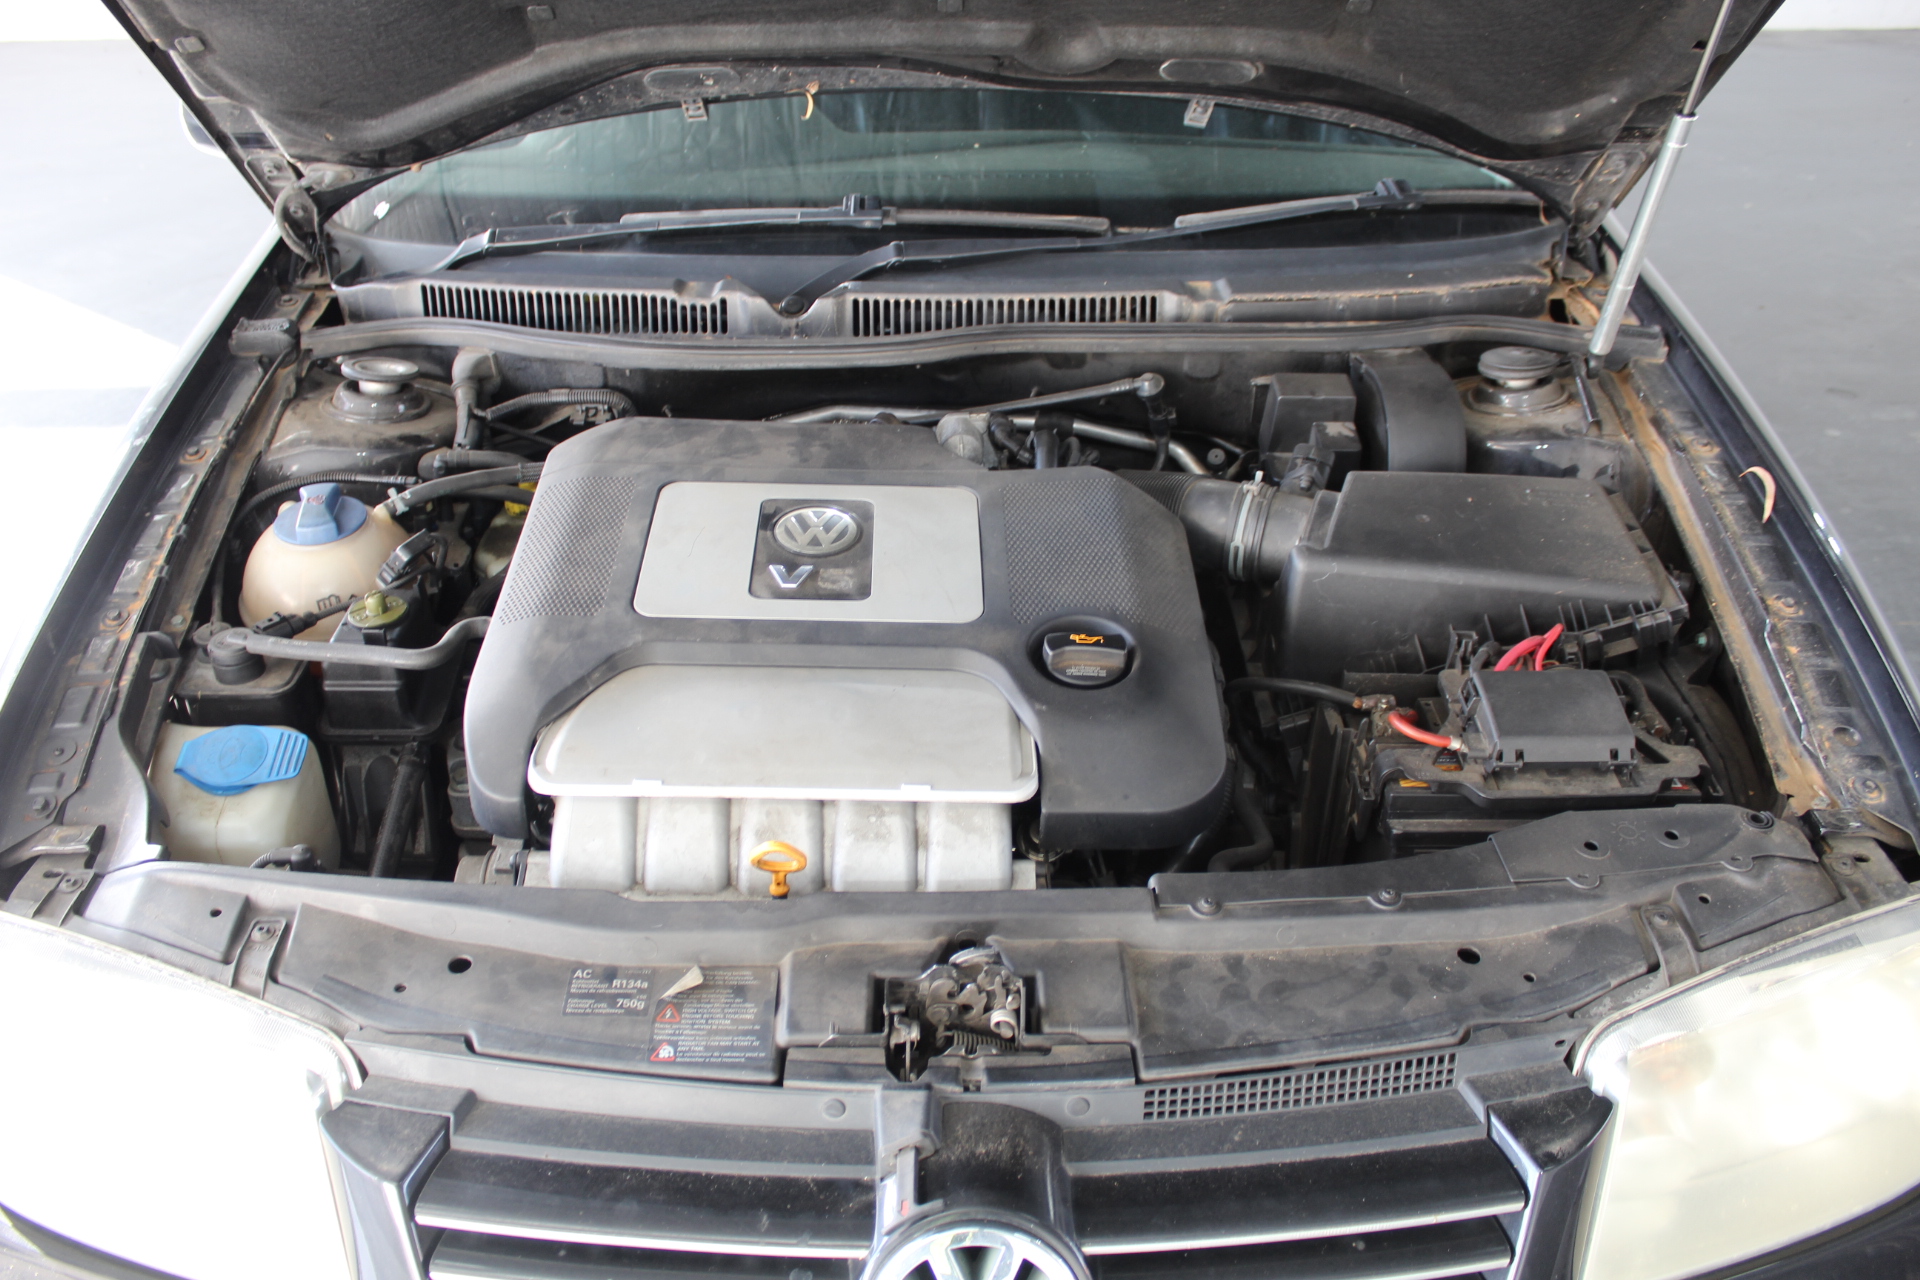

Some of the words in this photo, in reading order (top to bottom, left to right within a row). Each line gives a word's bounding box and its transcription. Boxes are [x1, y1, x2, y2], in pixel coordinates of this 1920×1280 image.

[573, 968, 592, 979] AC
[612, 979, 649, 989] R134a
[616, 998, 646, 1011] 750g
